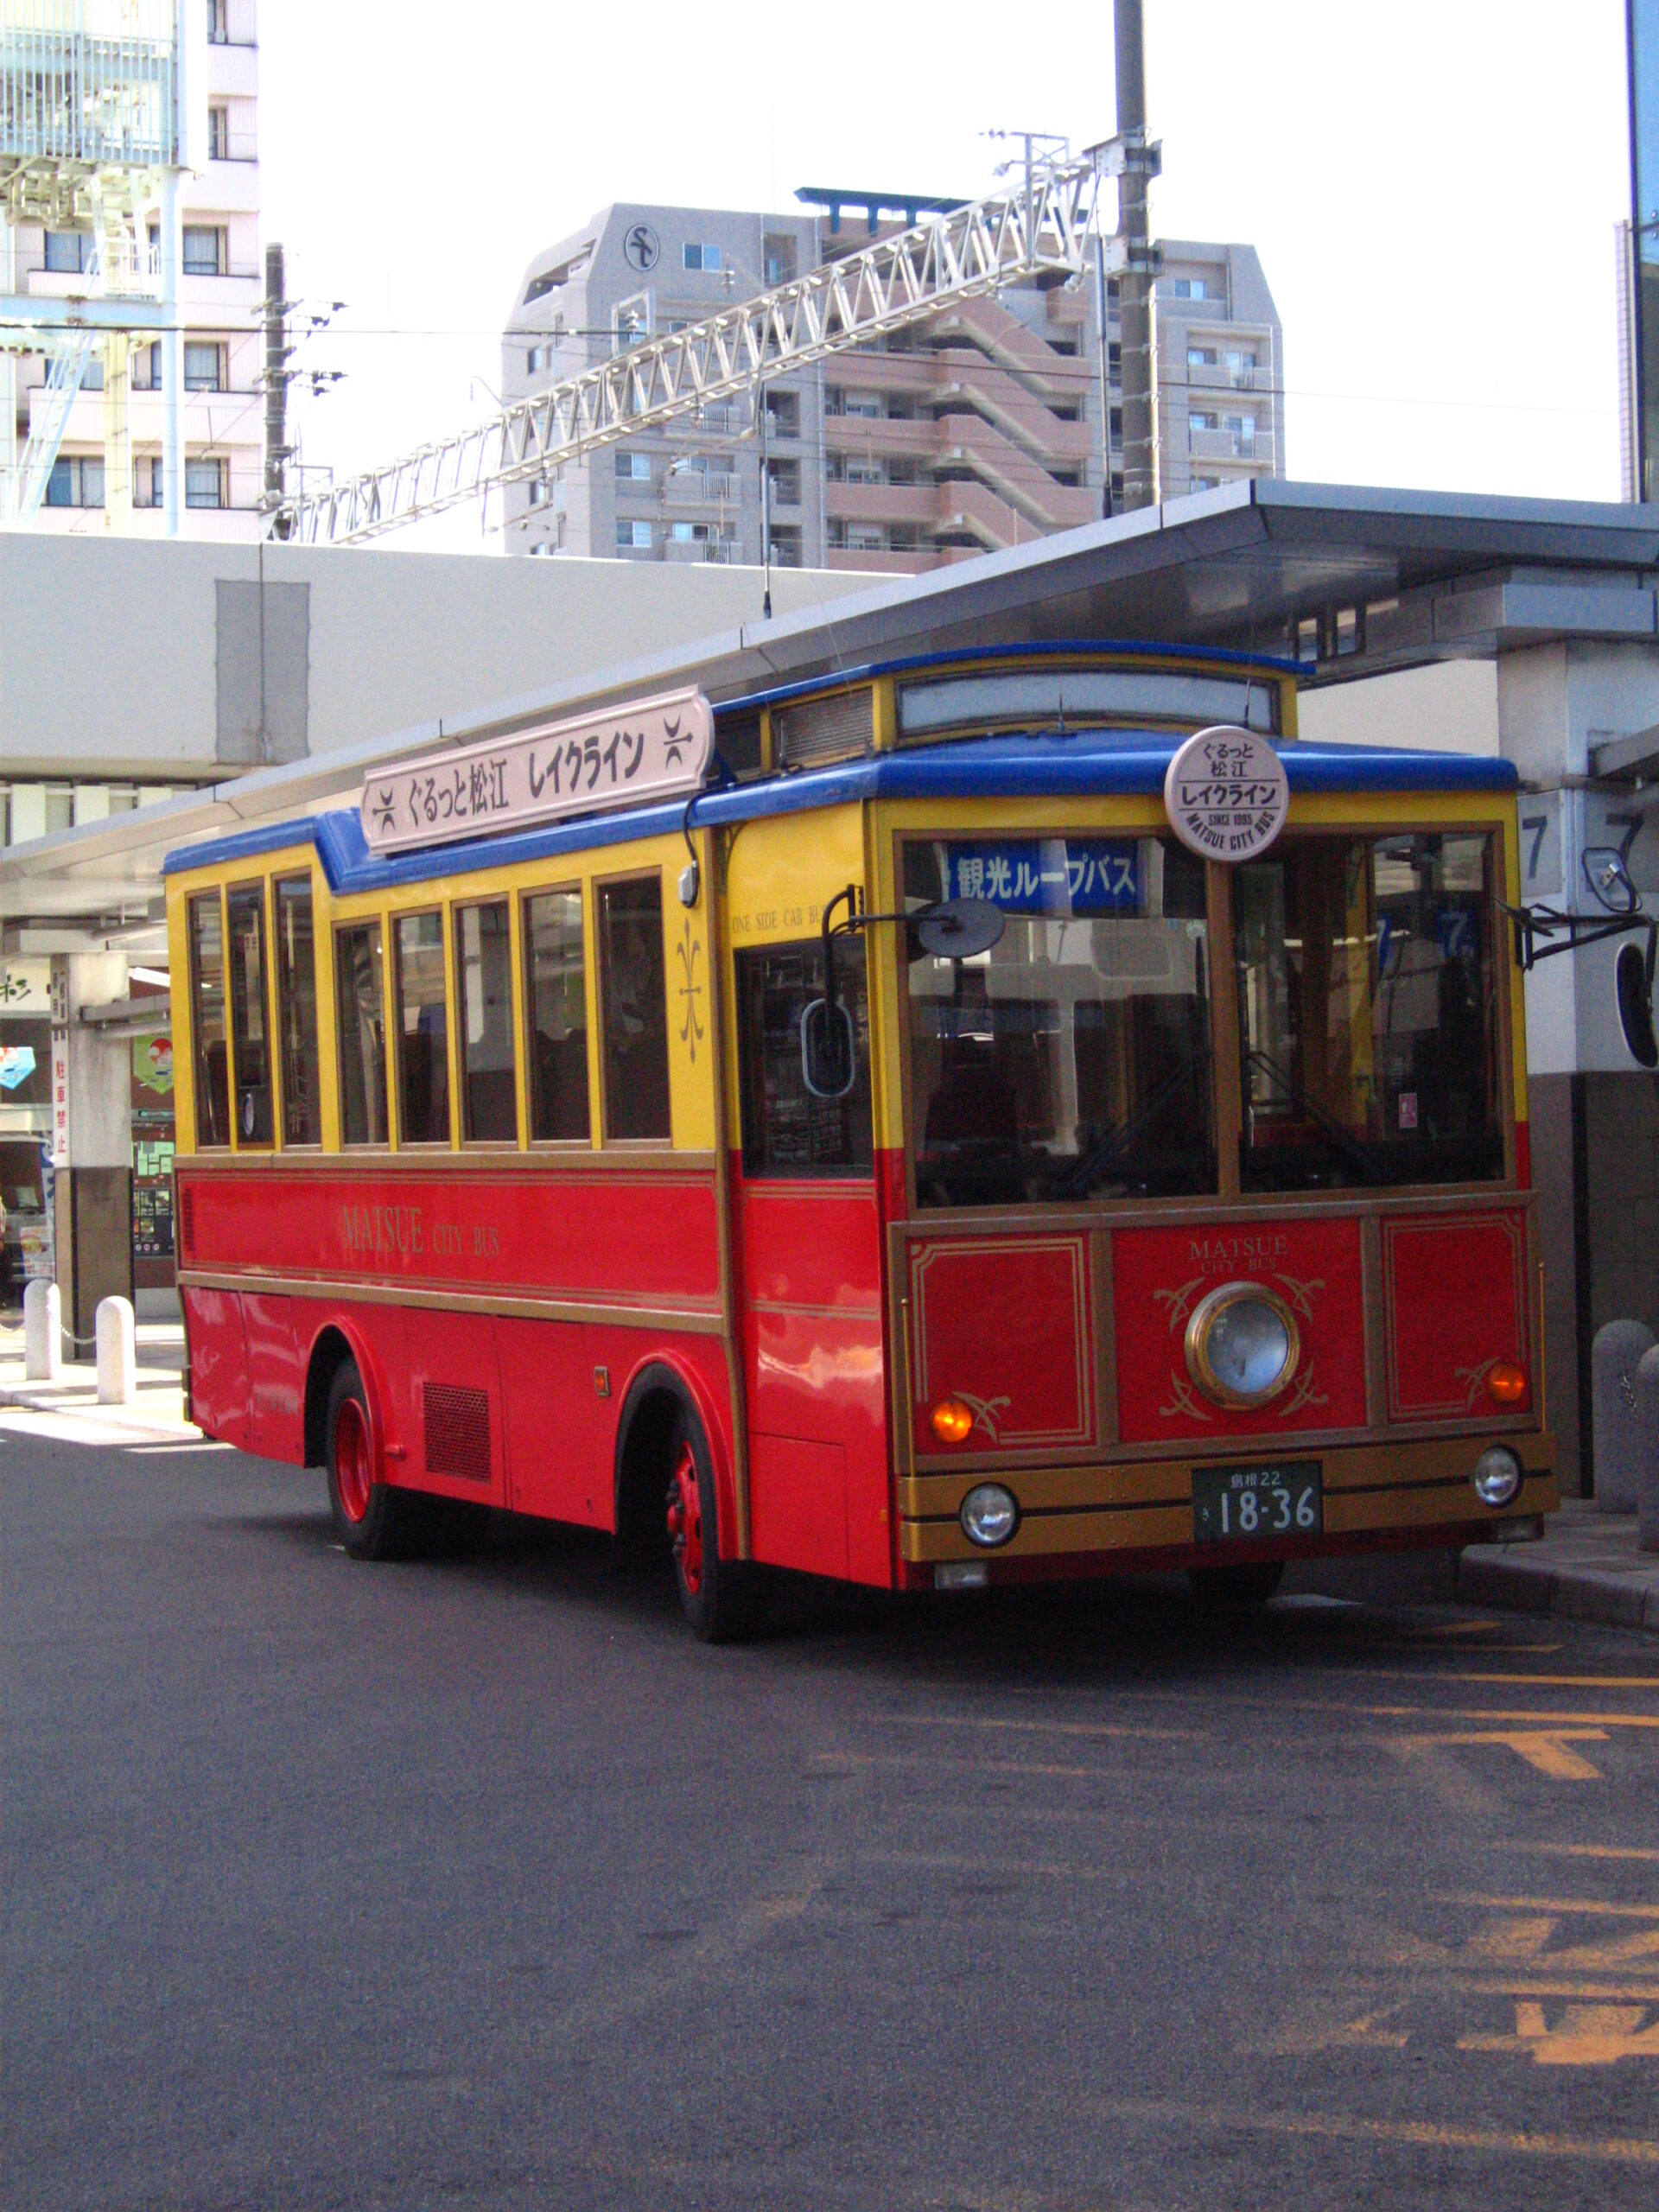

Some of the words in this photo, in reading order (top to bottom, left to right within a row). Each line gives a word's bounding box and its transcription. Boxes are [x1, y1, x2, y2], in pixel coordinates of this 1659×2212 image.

[1204, 743, 1254, 760] ぐるっと
[409, 757, 509, 827] ぐるっと松江
[529, 731, 644, 798] レイクライン
[1211, 760, 1248, 778] 松江
[1182, 784, 1275, 805] レイクライン
[1185, 812, 1225, 849] MATSUE
[1230, 830, 1254, 850] CITY
[1255, 810, 1274, 836] BUS
[1208, 813, 1230, 826] SINCE
[1234, 813, 1252, 825] 1995
[1522, 816, 1547, 880] 7
[957, 852, 1136, 900] 観光ループバス
[732, 914, 751, 934] ONE
[756, 911, 778, 931] SIDE
[784, 907, 803, 927] CAB
[56, 1059, 67, 1154] 駐車禁止
[343, 1206, 423, 1254] MATSUE
[433, 1224, 463, 1255] CITY
[473, 1226, 499, 1256] BUS
[1190, 1236, 1287, 1260] MATSUE
[1201, 1260, 1236, 1274] CITY
[1249, 1257, 1276, 1272] BUS
